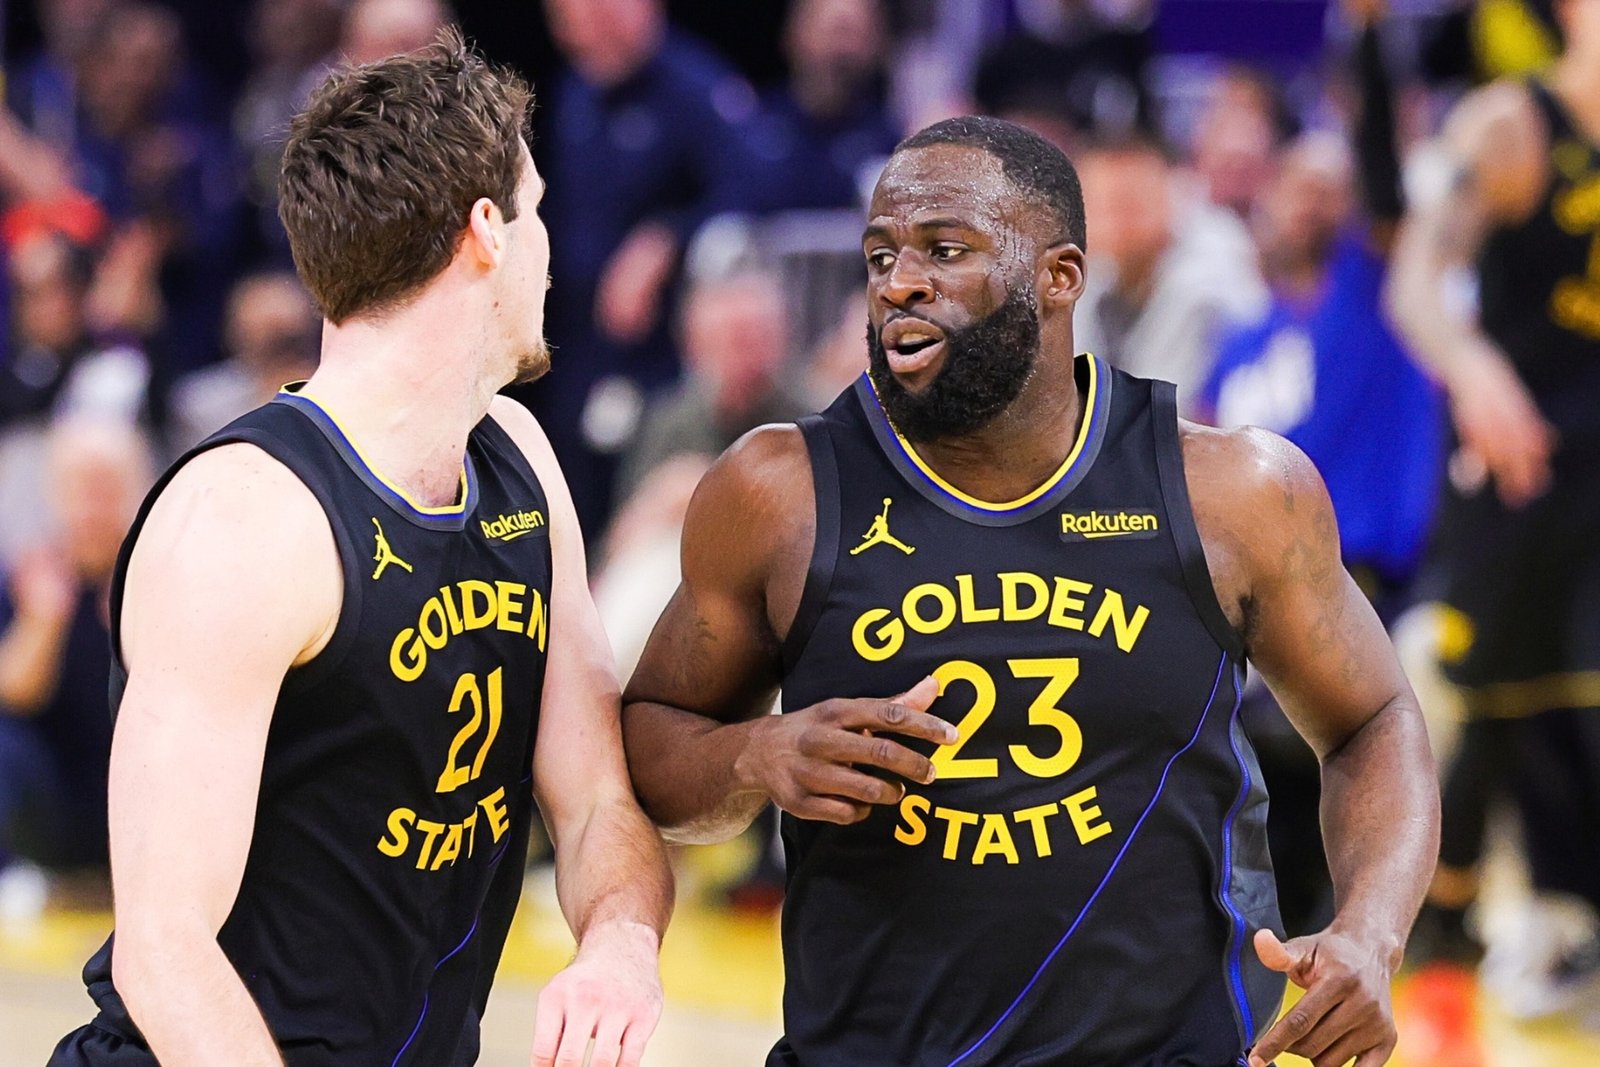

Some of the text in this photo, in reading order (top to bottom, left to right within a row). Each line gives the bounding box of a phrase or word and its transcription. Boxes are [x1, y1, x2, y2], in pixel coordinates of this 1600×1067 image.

[480, 510, 545, 539] Rakuten
[1062, 511, 1158, 534] Rakuten
[389, 579, 547, 682] GOLDEN
[852, 572, 1150, 661] GOLDEN
[435, 666, 503, 793] 21
[928, 658, 1083, 779] 23
[377, 786, 510, 871] STATE
[894, 785, 1112, 865] STATE
